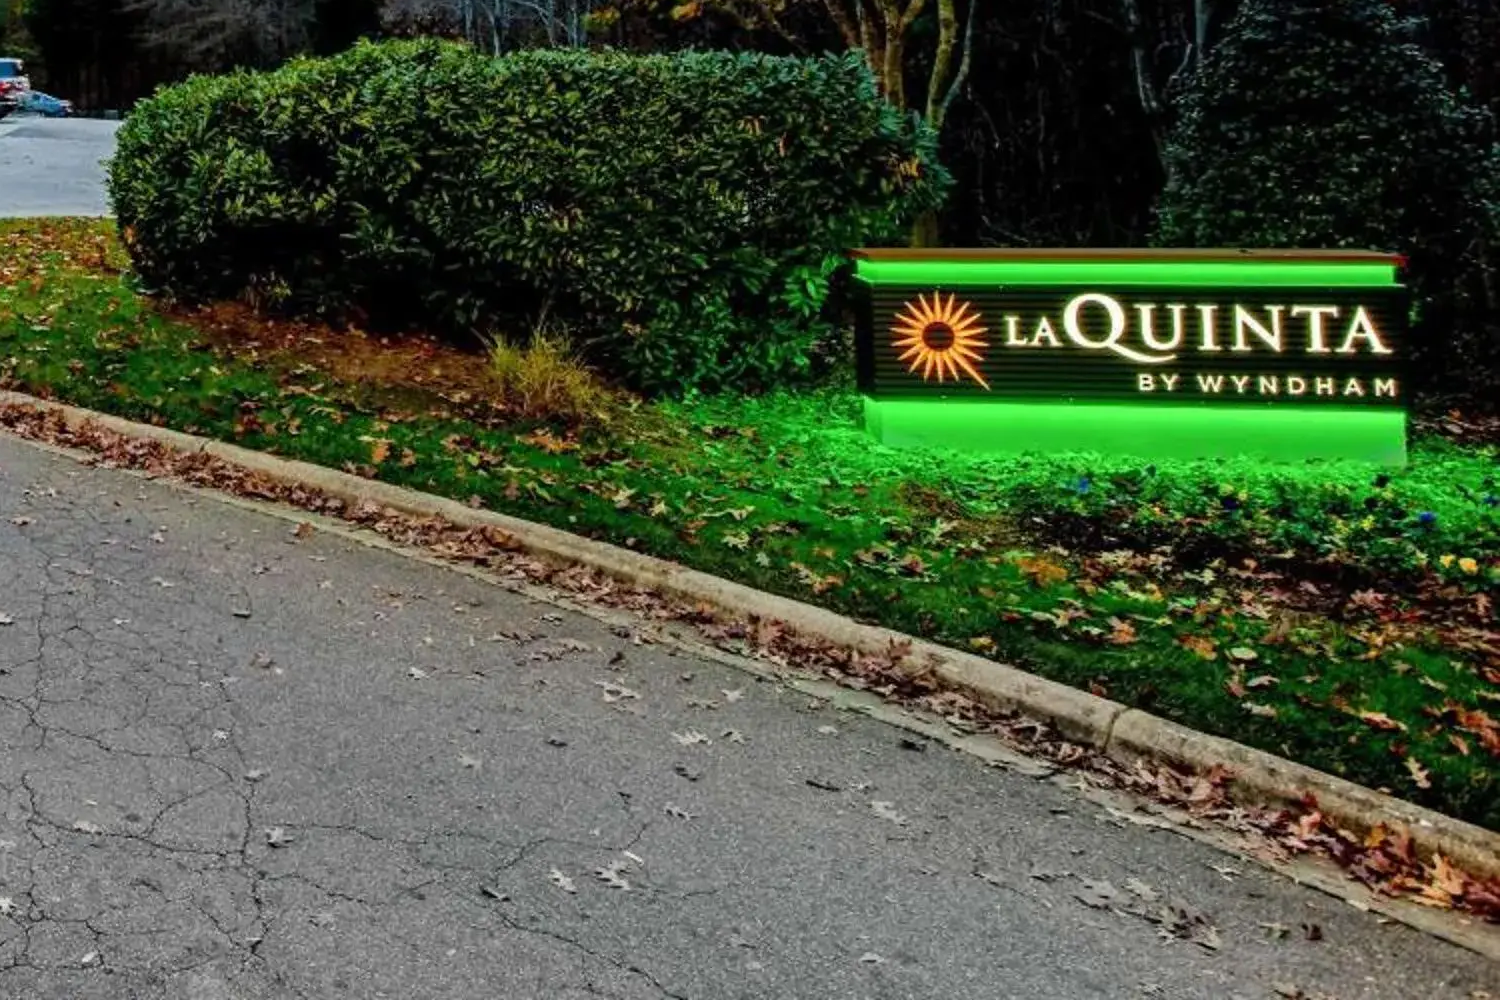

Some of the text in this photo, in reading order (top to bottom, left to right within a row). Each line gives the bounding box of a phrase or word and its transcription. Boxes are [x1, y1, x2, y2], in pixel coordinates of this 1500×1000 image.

[1063, 293, 1393, 363] QUINTA
[1138, 373, 1398, 397] BY WYNDHAM
